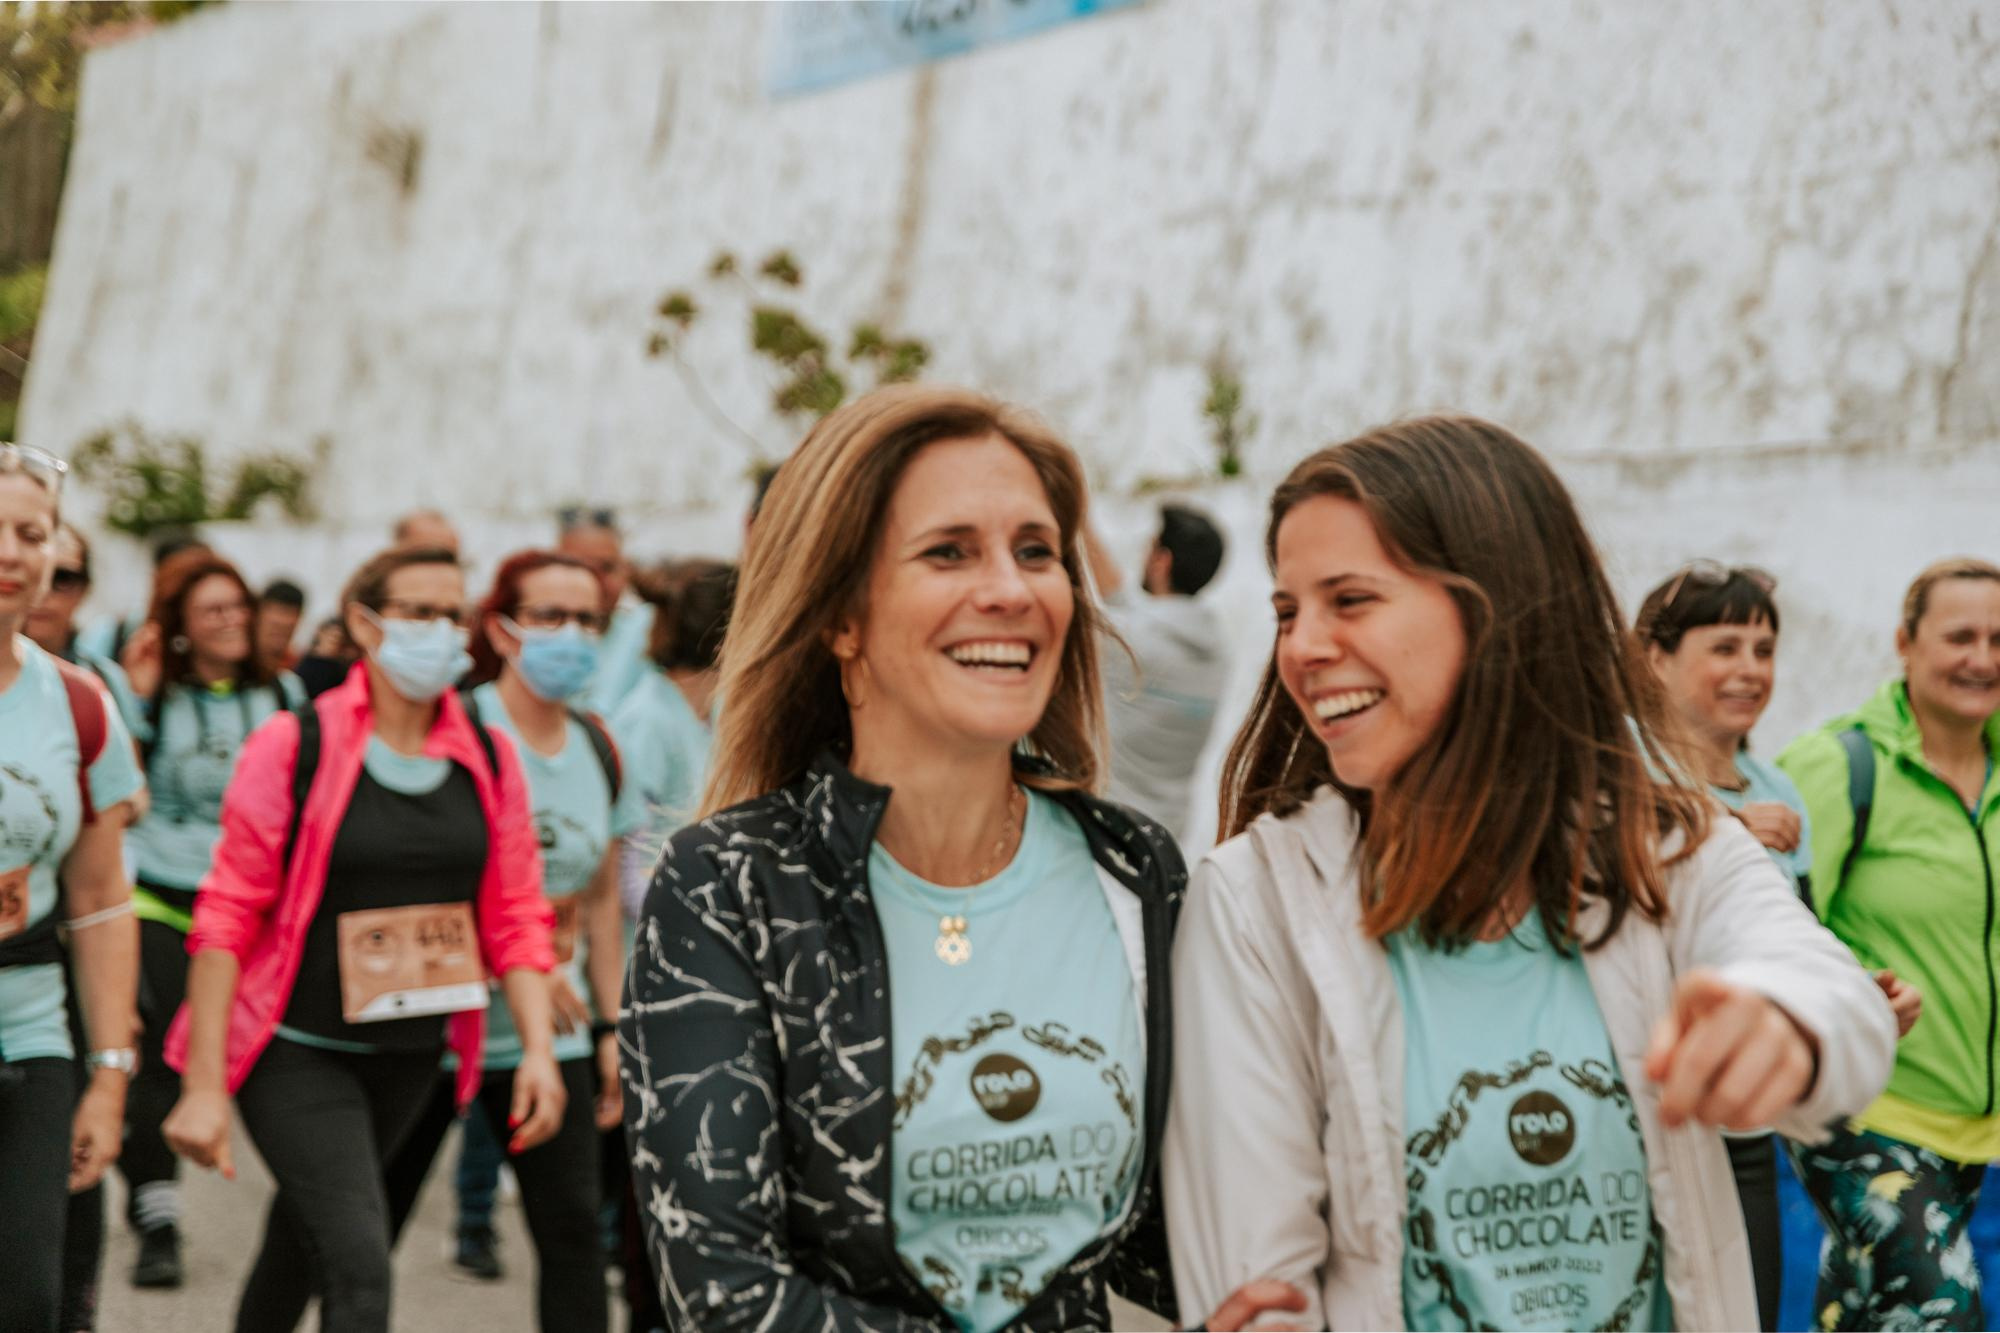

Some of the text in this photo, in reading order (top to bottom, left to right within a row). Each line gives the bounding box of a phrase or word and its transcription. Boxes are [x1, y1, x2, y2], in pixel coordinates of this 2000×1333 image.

[907, 1122, 1117, 1182] CORRIDA DO
[907, 1160, 1108, 1214] CHOCOLATE
[1445, 1169, 1645, 1221] CORRIDA DO
[1451, 1209, 1640, 1259] CHOCOLATE
